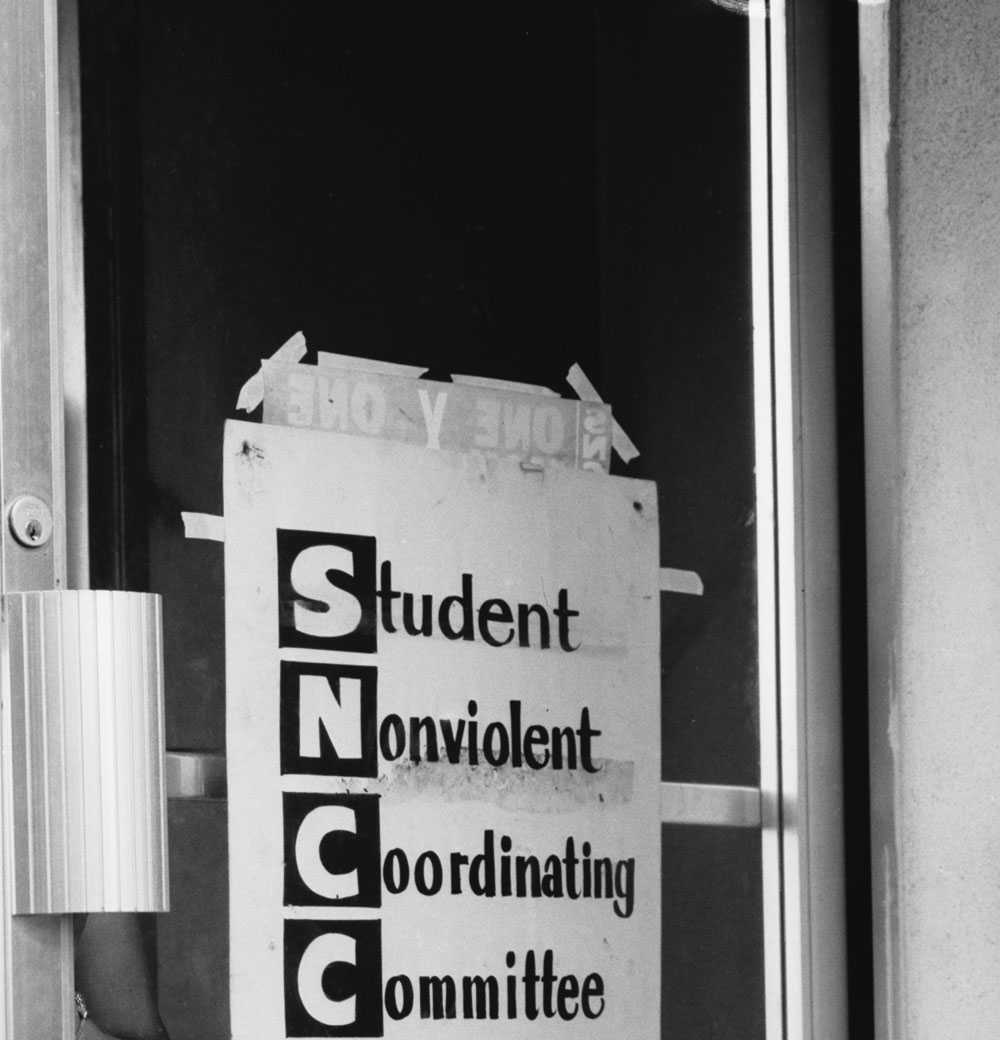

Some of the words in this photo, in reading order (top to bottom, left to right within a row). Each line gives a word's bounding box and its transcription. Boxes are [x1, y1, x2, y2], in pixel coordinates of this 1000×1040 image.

[290, 544, 582, 652] Student
[299, 674, 602, 773] Nonviolent
[295, 804, 635, 918] Coordinating
[297, 932, 605, 1026] Committee
